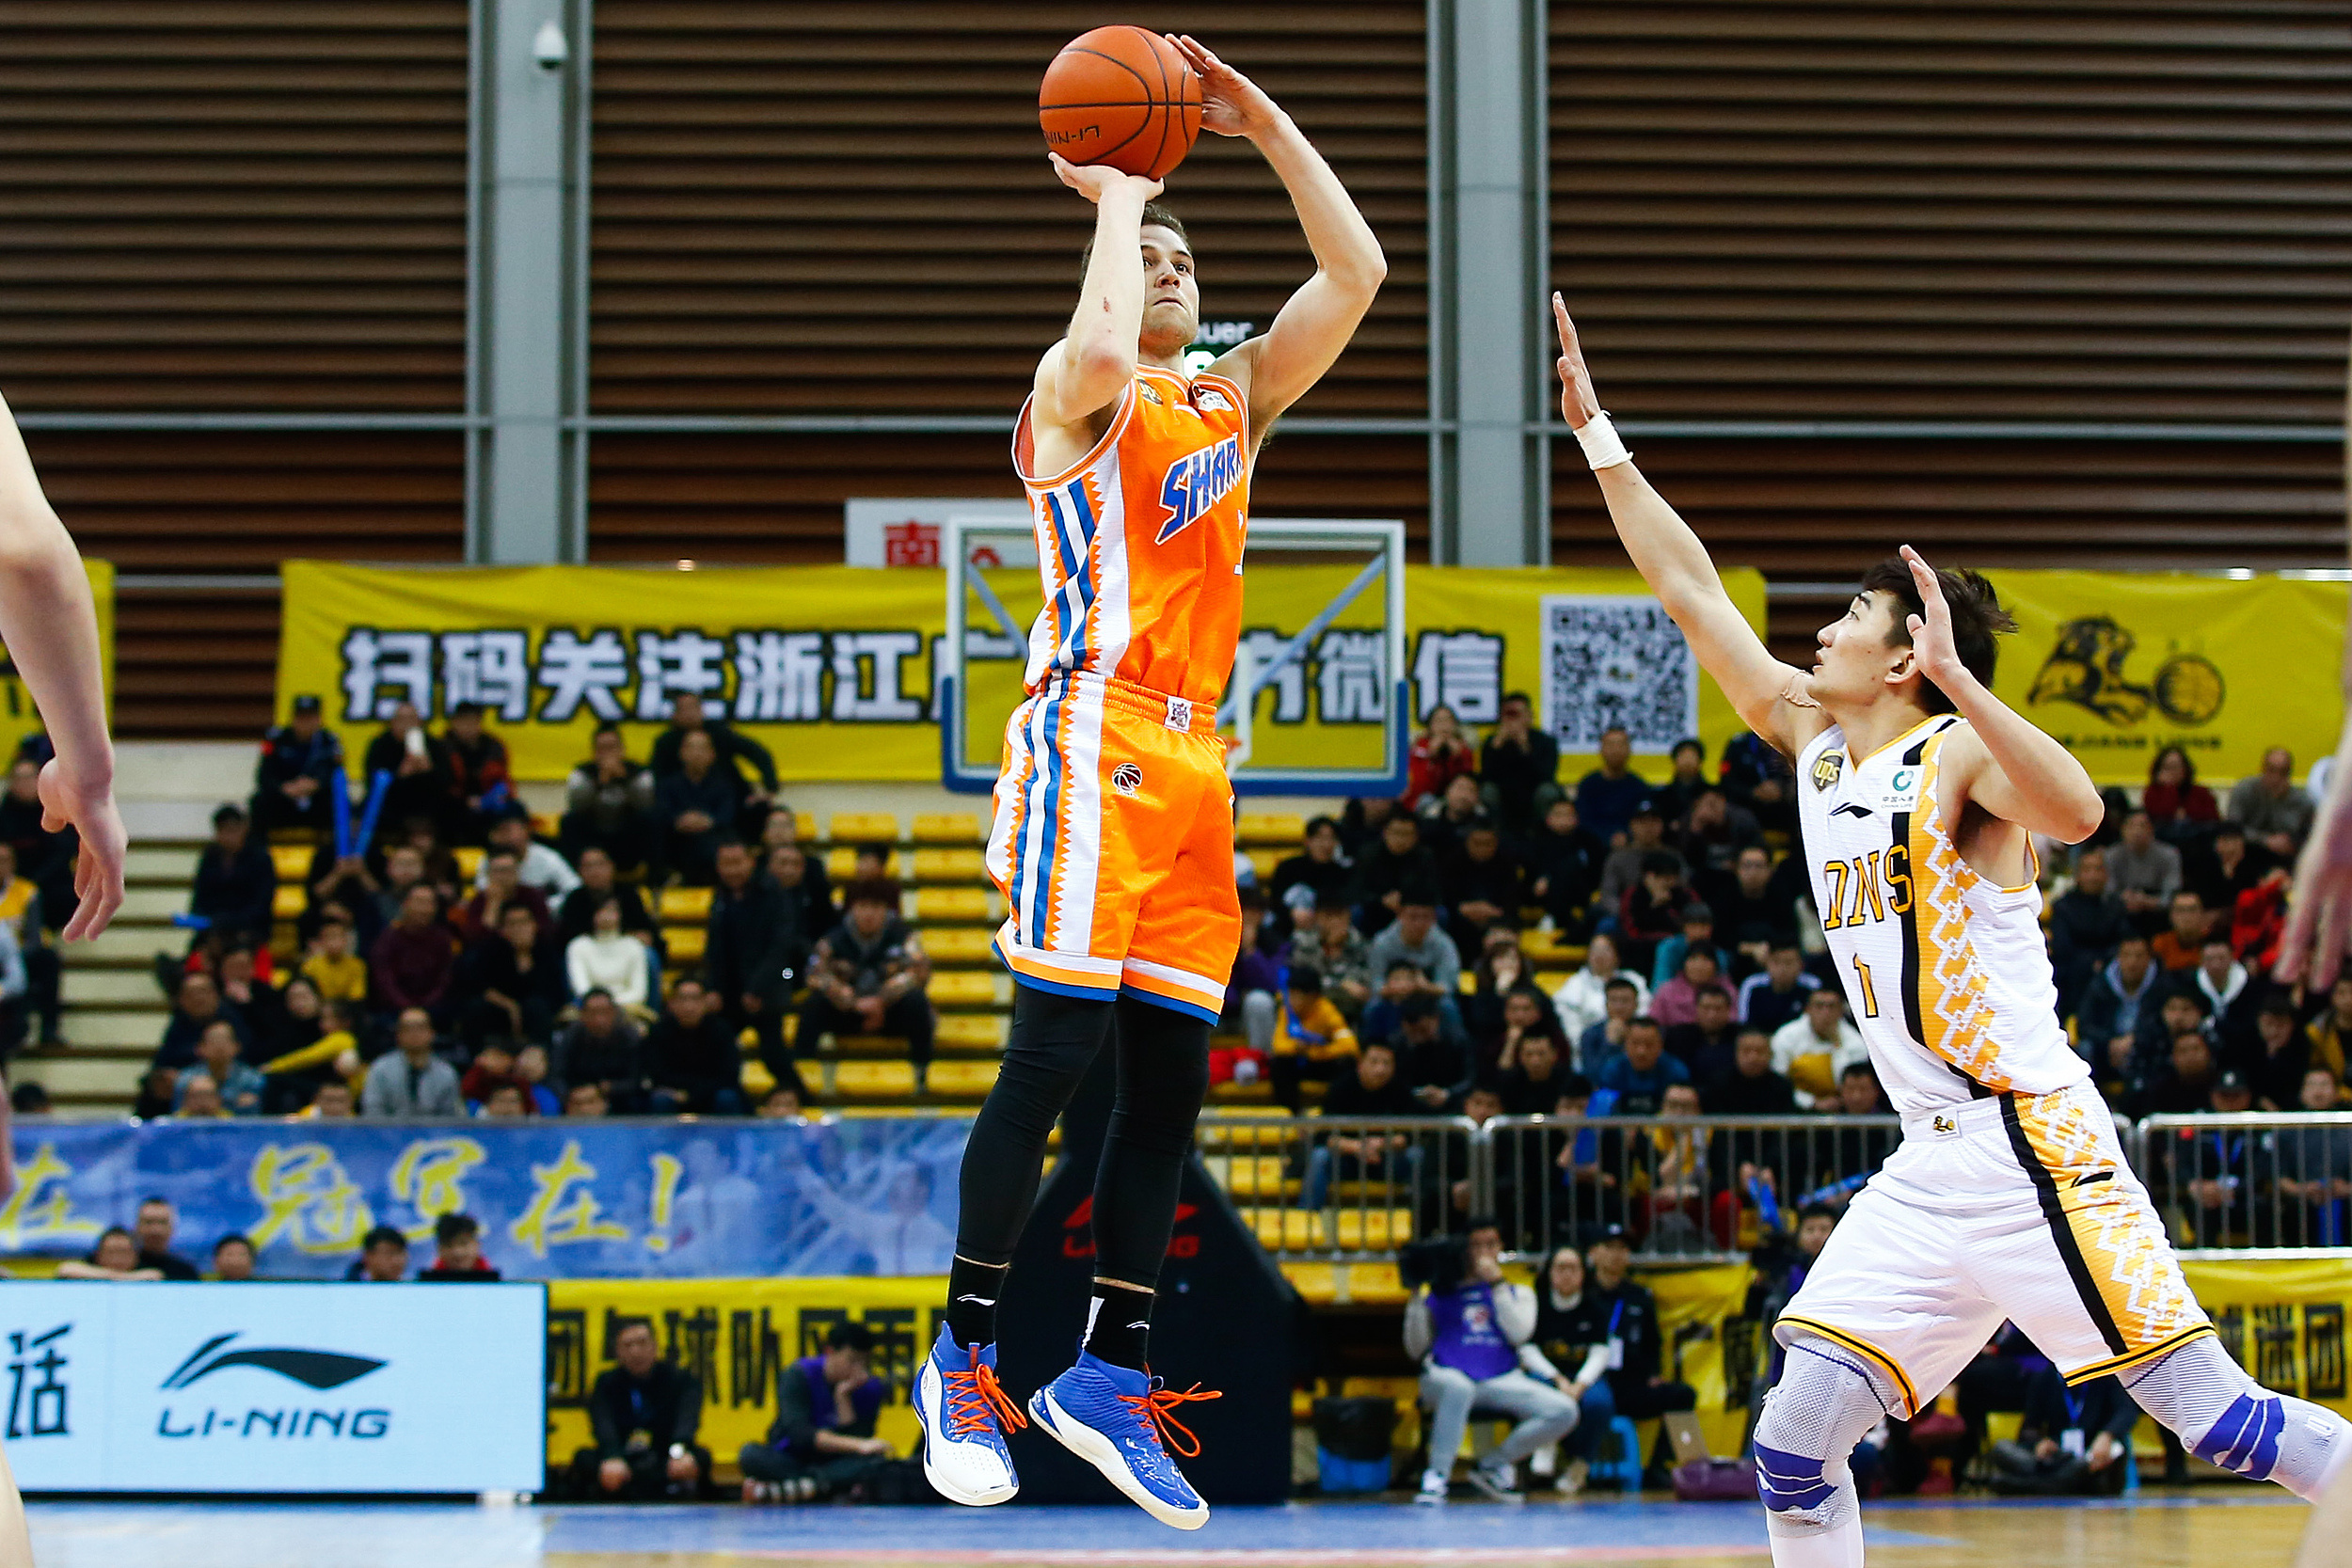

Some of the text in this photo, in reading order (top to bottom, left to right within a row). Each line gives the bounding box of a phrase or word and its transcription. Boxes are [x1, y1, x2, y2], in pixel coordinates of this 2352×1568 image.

[1154, 432, 1245, 546] SHAR
[1814, 758, 1840, 786] ups
[1852, 952, 1880, 1019] 1
[6, 1323, 75, 1439] 话
[157, 1408, 391, 1439] LI-NING
